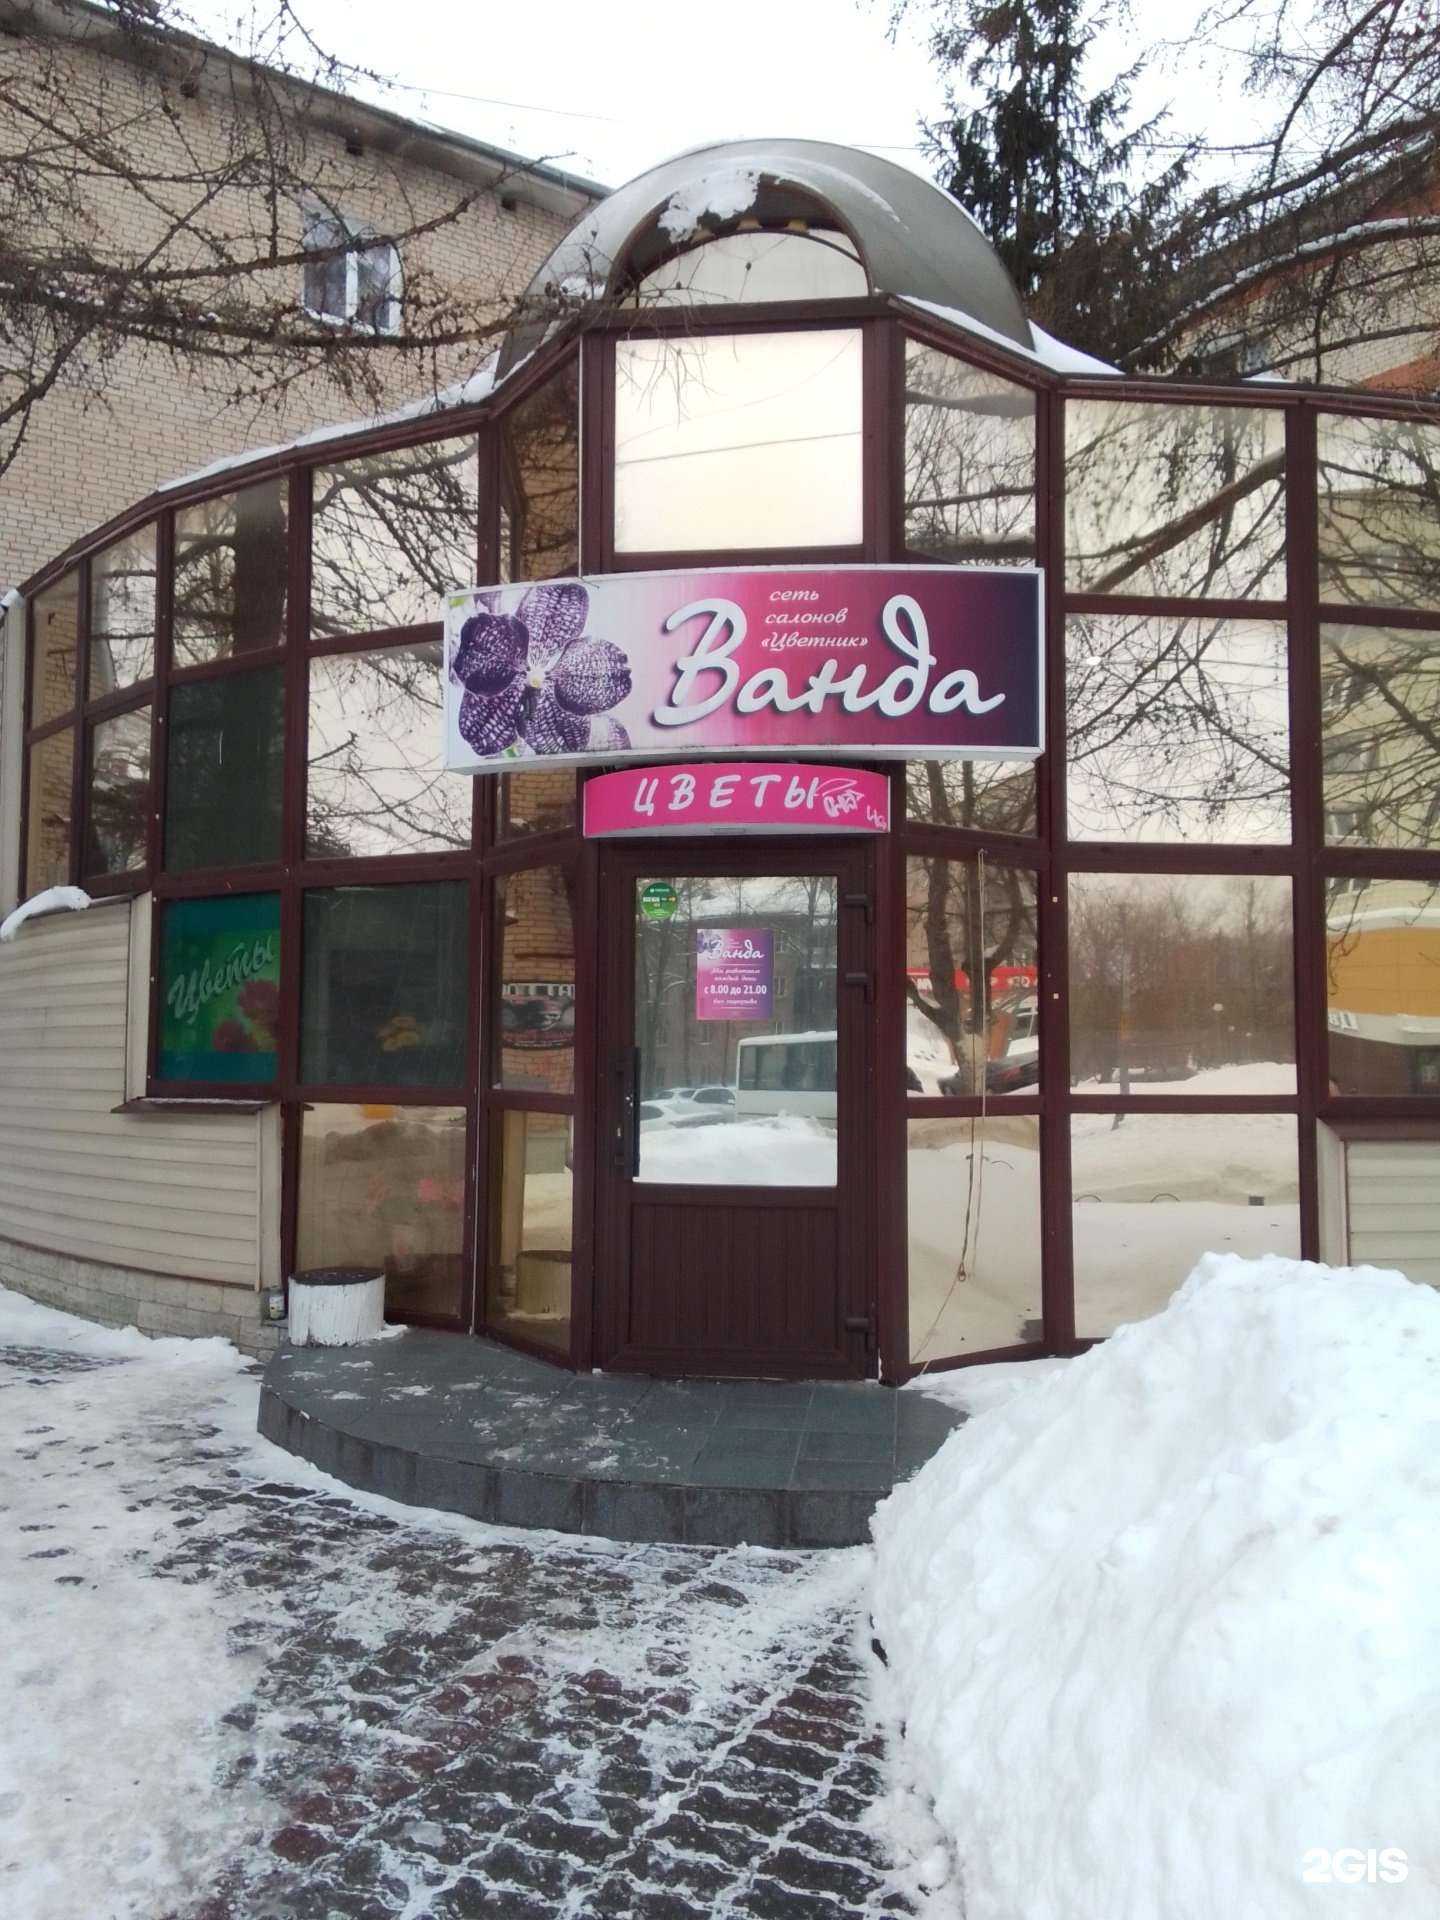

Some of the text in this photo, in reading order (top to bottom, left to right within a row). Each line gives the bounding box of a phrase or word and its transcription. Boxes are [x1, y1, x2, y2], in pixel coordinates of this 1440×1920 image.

[768, 587, 820, 603] сеть
[764, 607, 848, 626] салонов
[760, 631, 869, 651] «Цветник»
[652, 593, 1006, 727] Ванда
[633, 773, 818, 814] ЦВЕТЫ
[707, 939, 765, 959] Ванда
[167, 934, 274, 1024] Цветы
[710, 984, 729, 994] 8.00
[730, 986, 742, 995] до
[743, 984, 768, 994] 21.00
